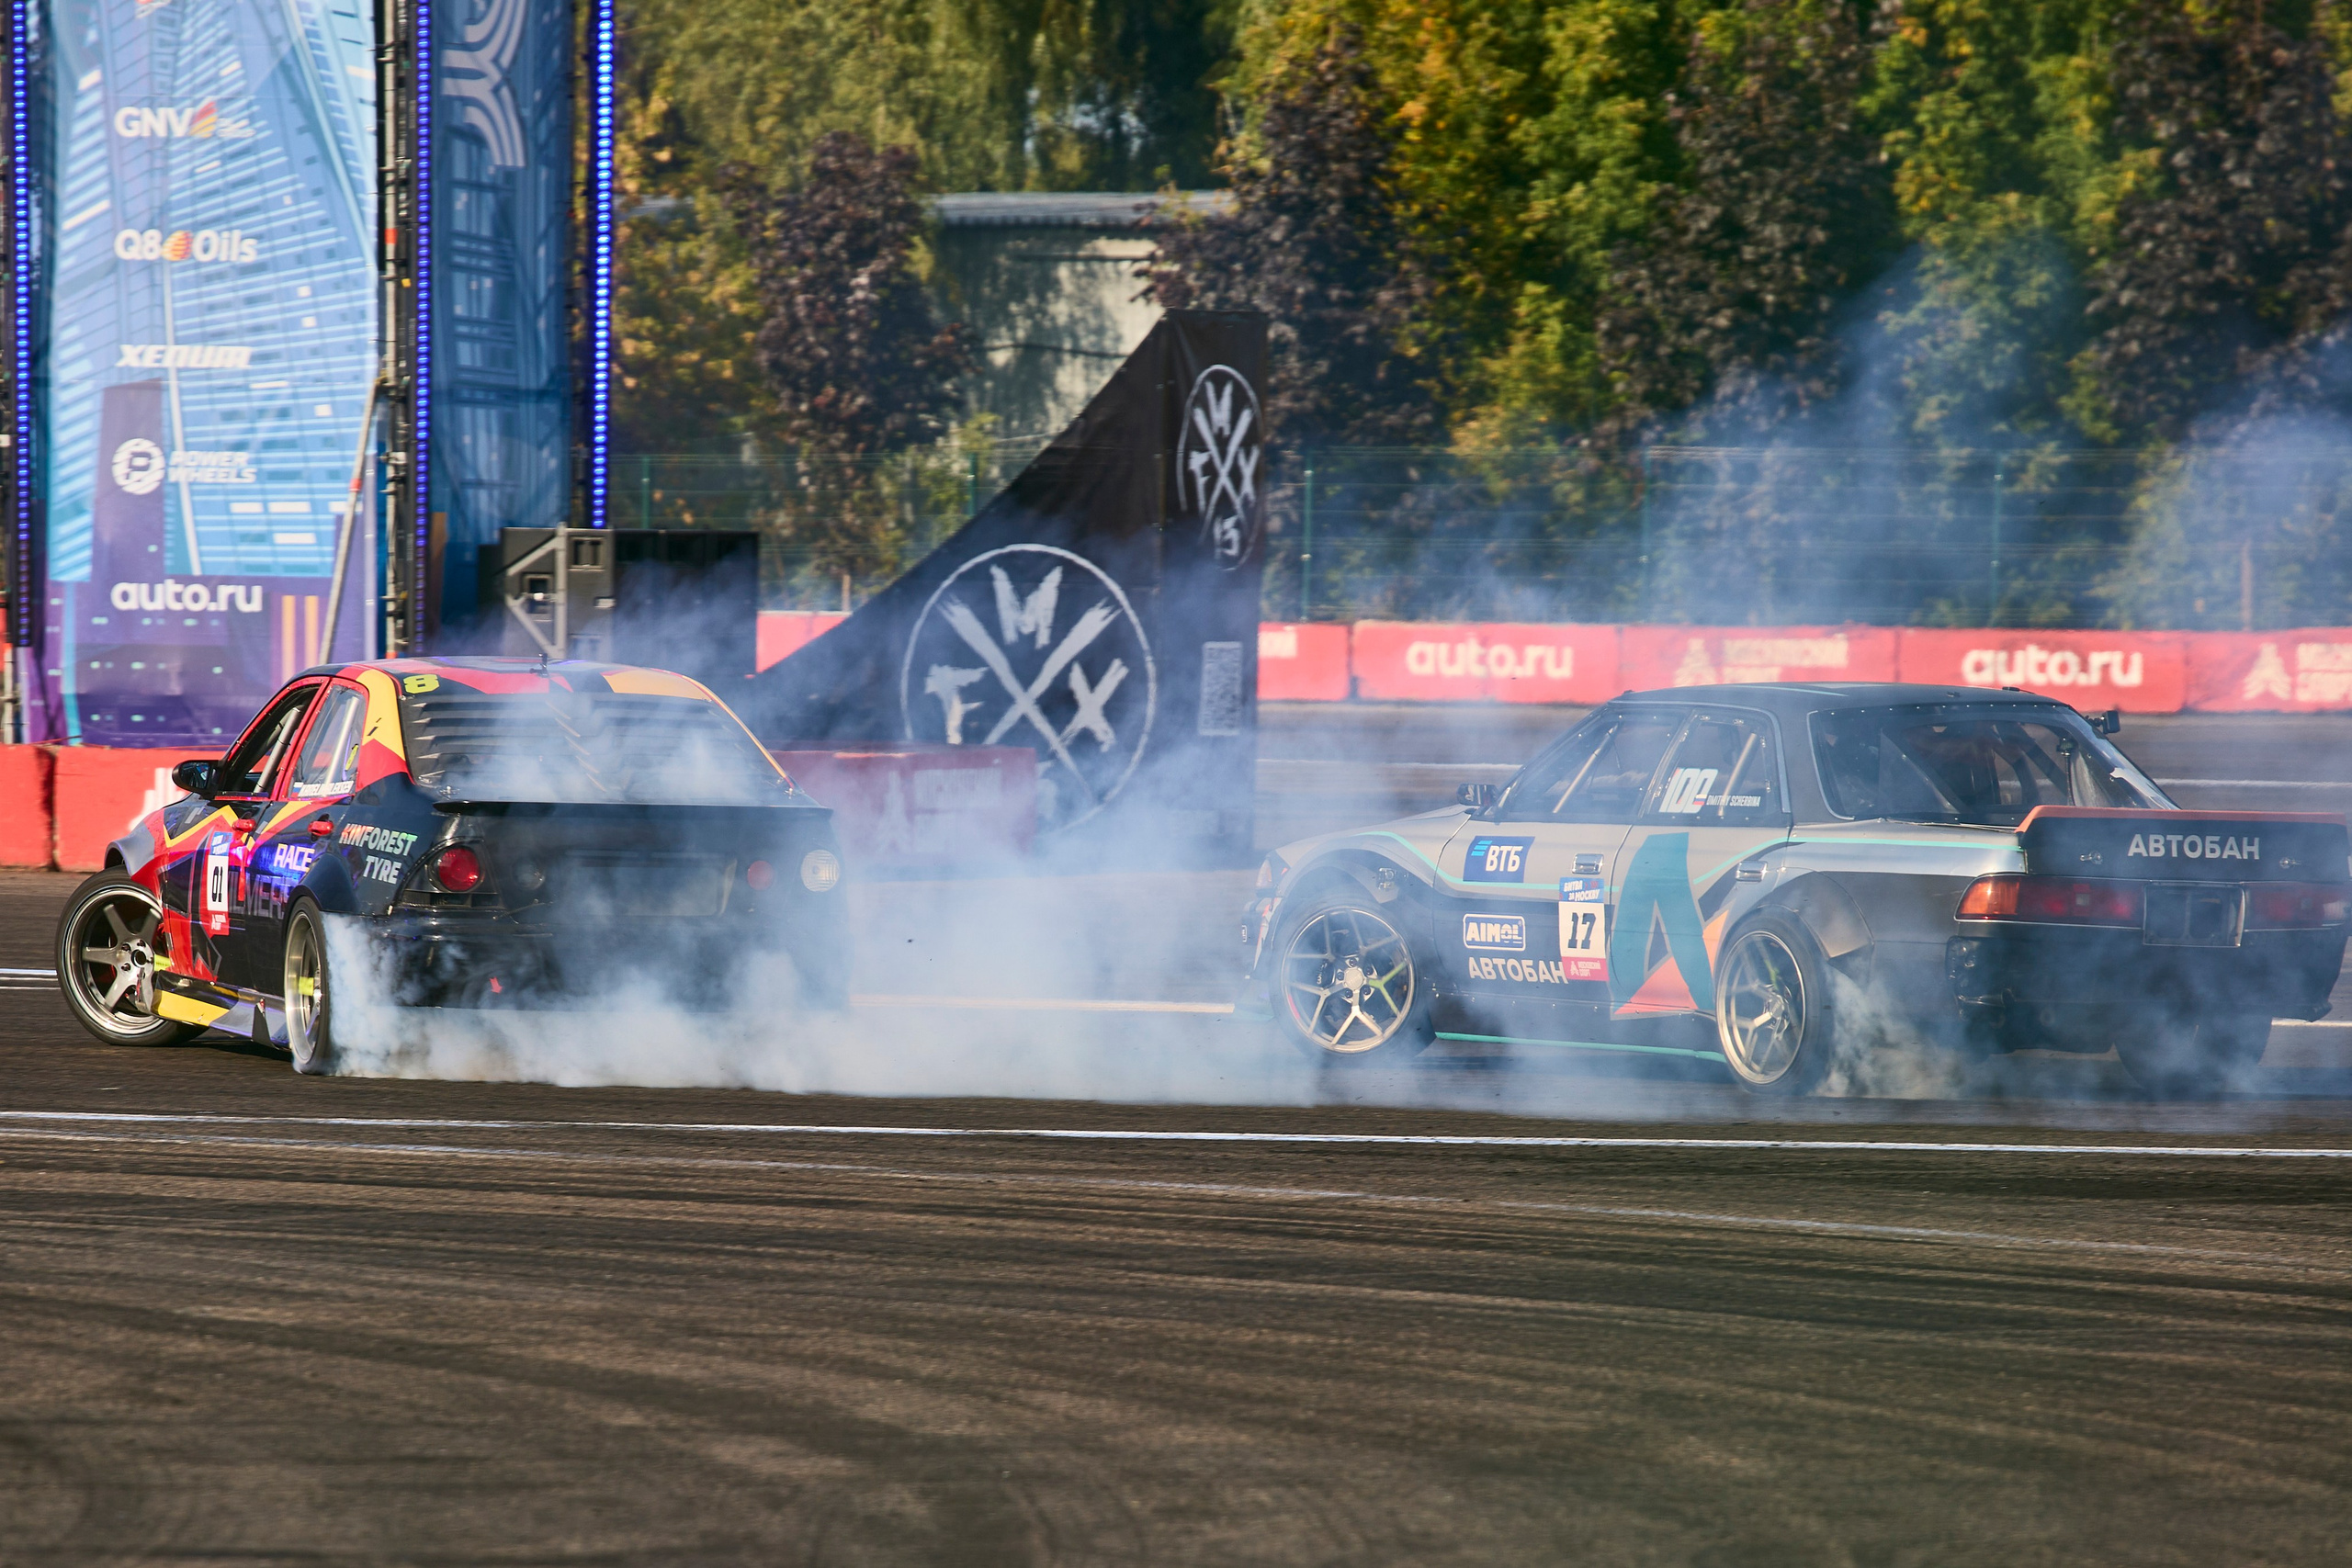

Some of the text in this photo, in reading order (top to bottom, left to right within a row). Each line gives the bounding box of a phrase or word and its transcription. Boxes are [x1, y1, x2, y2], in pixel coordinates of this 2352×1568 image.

[114, 106, 194, 138] GNV
[114, 229, 258, 263] Q8 Oils
[169, 451, 251, 467] POWER
[167, 468, 257, 484] WHEELS
[110, 579, 264, 614] auto.ru
[1406, 633, 1574, 679] auto.ru
[1961, 644, 2143, 687] auto.ru
[403, 674, 440, 694] 8
[338, 823, 418, 856] KINFOREST
[2127, 833, 2260, 860] АВТОБАН
[273, 843, 316, 873] RACE
[363, 855, 402, 885] TYRE
[1485, 845, 1524, 872] ВТБ
[211, 865, 223, 902] 01
[1465, 921, 1523, 944] AIMOL
[1567, 912, 1597, 950] 17
[1468, 956, 1569, 985] АВТОБАН
